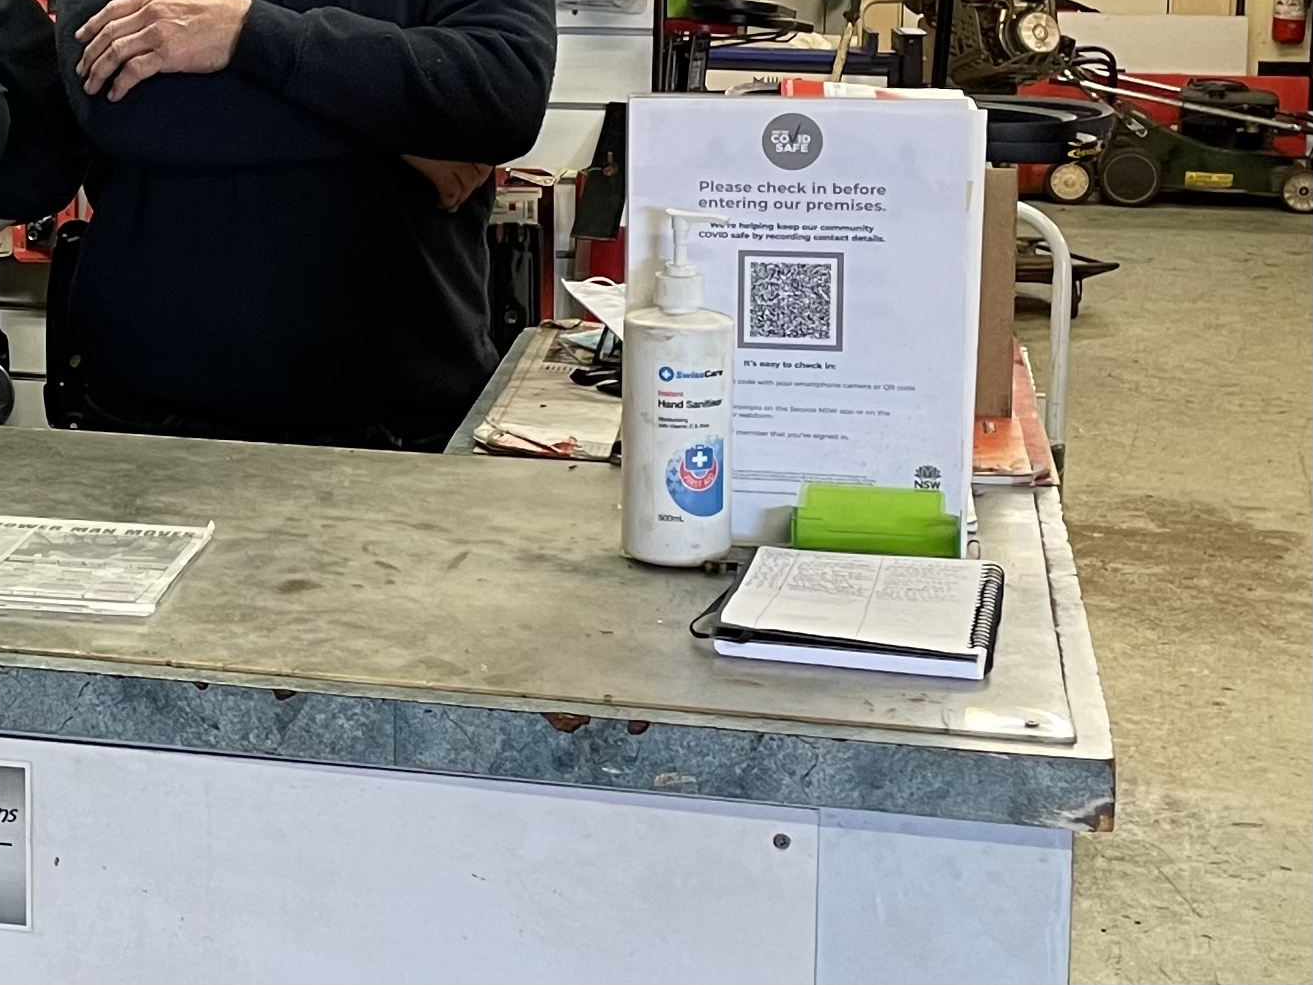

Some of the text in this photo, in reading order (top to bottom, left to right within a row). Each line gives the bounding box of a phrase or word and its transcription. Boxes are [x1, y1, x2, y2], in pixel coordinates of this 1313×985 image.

[775, 143, 809, 153] SAFE
[699, 181, 887, 196] Please check in before
[698, 197, 887, 213] entering our premises.
[739, 222, 774, 232] helping
[776, 223, 800, 232] keep
[820, 224, 875, 233] community
[698, 231, 729, 239] COVID
[731, 231, 750, 239] safe
[752, 232, 764, 241] by
[765, 233, 811, 242] recording
[813, 234, 849, 242] contact
[743, 359, 758, 368] It's
[759, 361, 780, 370] easy
[794, 361, 822, 370] check
[658, 399, 684, 409] Hand
[914, 479, 941, 489] NSW
[70, 526, 117, 535] MAN
